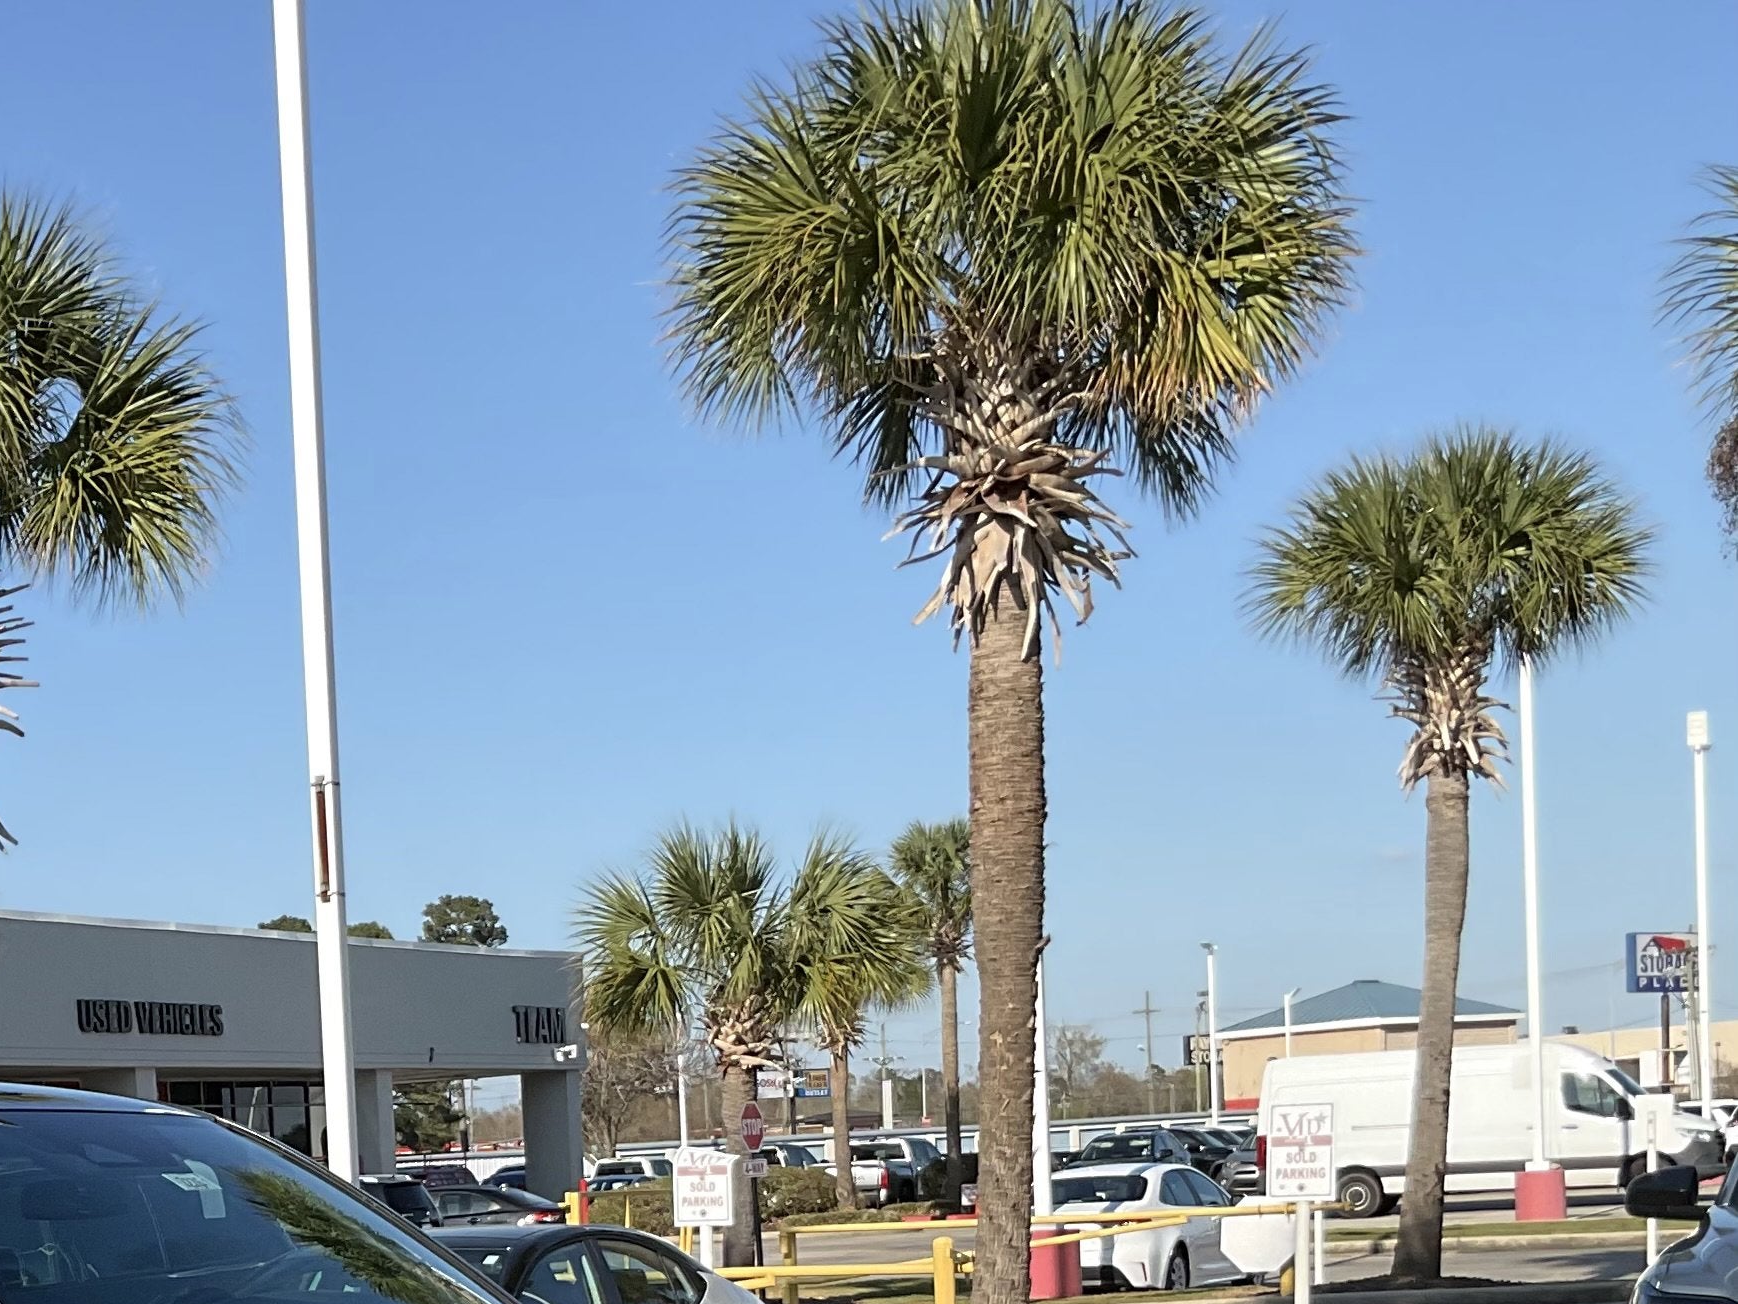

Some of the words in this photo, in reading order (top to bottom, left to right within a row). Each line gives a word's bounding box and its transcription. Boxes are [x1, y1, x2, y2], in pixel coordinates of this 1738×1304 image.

[76, 999, 133, 1033] USED
[134, 1001, 224, 1036] VEHICLES
[742, 1118, 763, 1136] STOP
[1286, 1151, 1317, 1164] SOLD
[1275, 1167, 1327, 1180] PARKING
[689, 1181, 716, 1193] SOLD
[682, 1196, 724, 1207] PARKING
